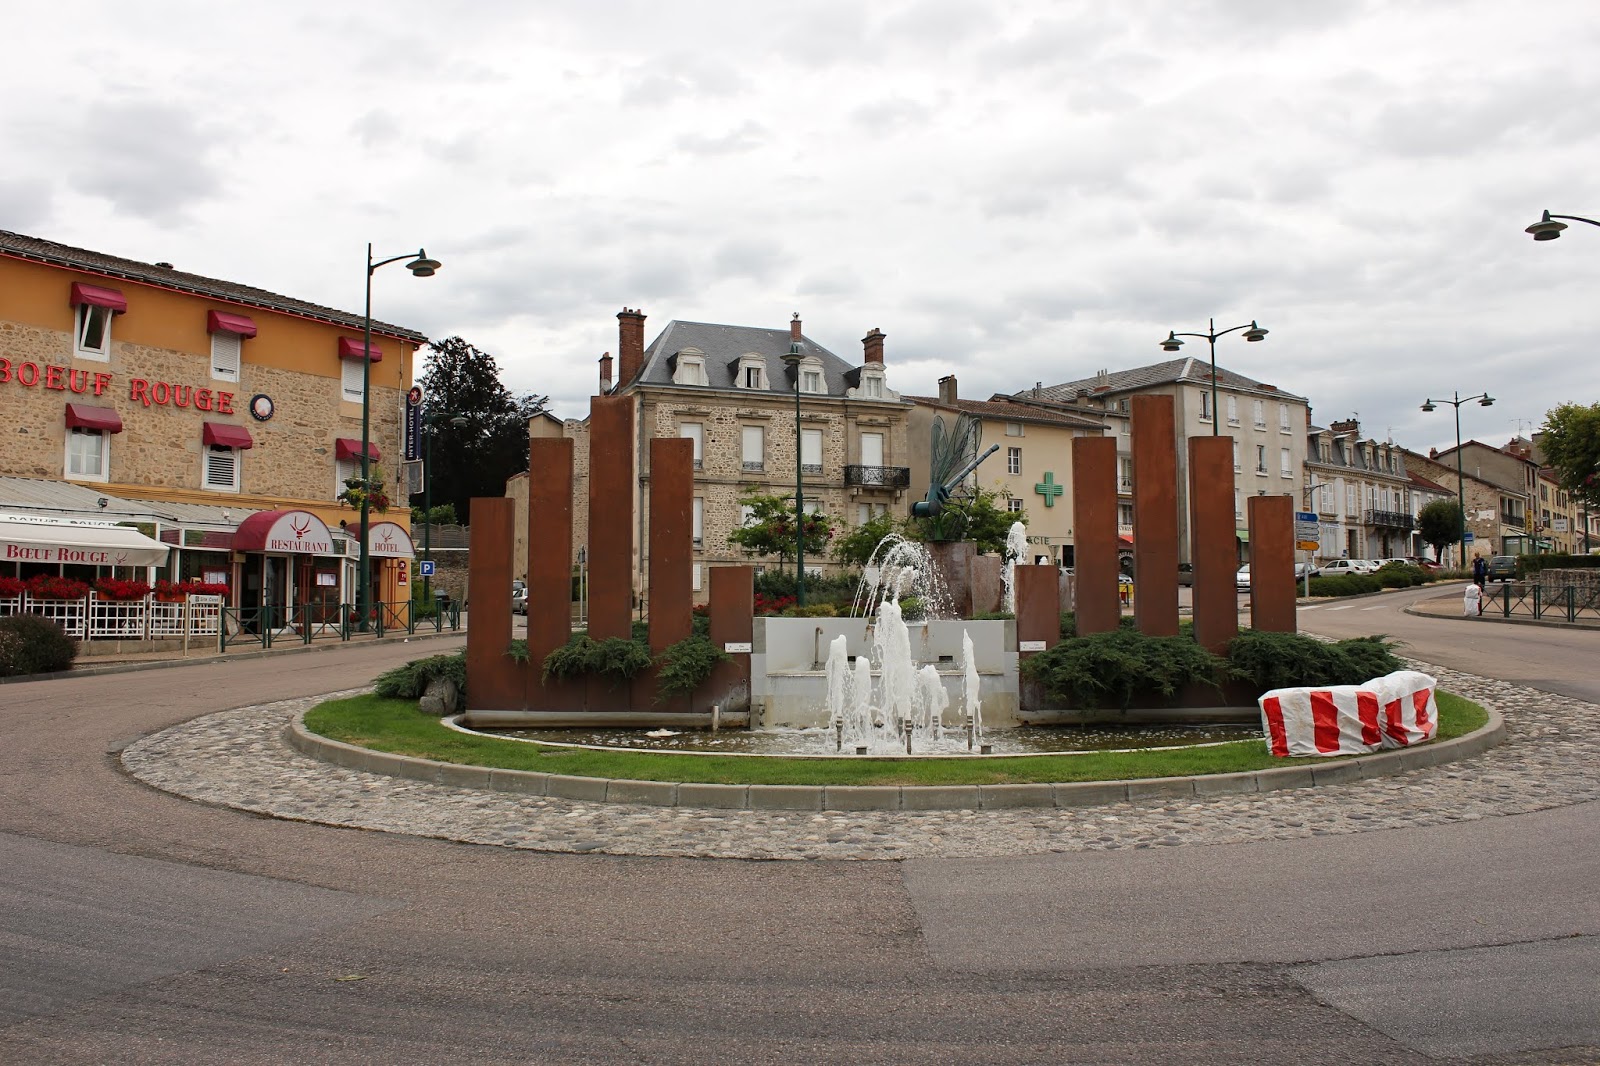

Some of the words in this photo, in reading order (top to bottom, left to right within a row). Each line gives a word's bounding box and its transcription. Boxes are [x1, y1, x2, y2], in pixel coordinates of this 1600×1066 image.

[130, 378, 234, 414] ROUGE
[271, 539, 329, 553] RESTAURANT
[374, 542, 400, 553] HOTEL
[6, 544, 53, 561] BŒUF
[57, 547, 109, 563] ROUGE
[423, 563, 431, 573] P
